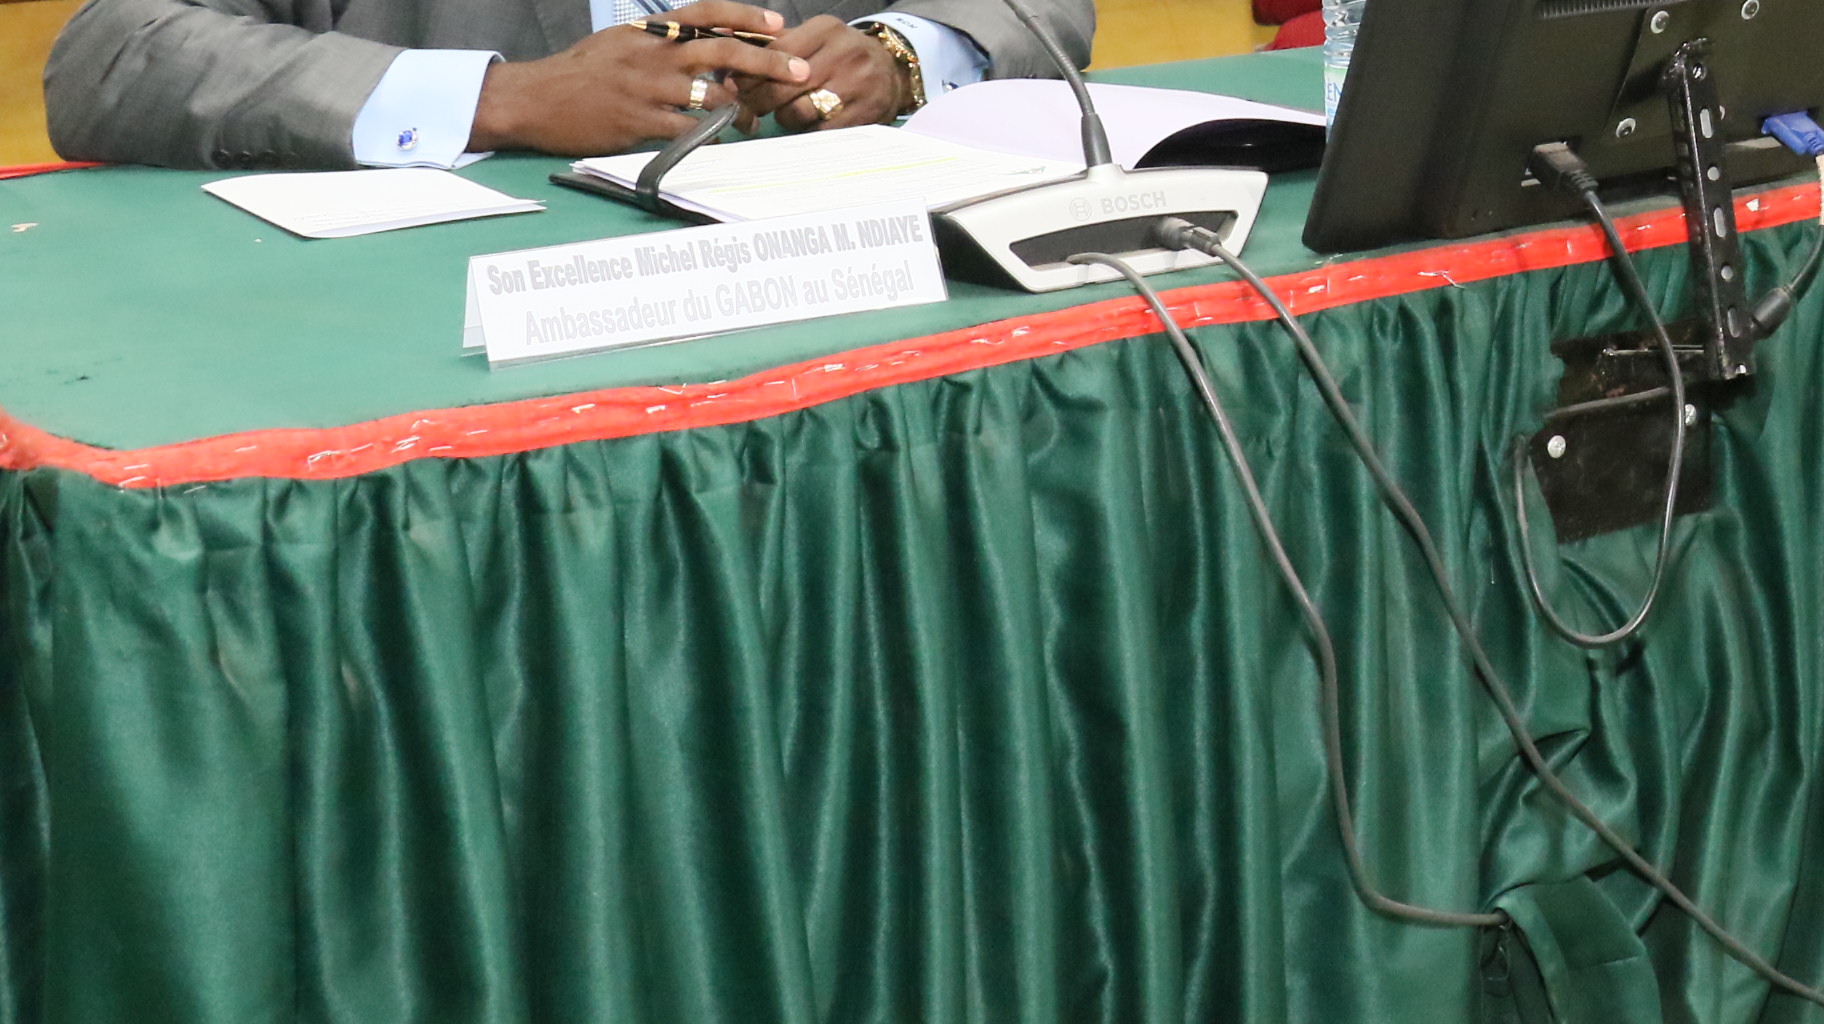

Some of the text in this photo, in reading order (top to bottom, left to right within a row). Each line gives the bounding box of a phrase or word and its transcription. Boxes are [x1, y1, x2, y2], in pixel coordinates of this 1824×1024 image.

[1101, 190, 1167, 214] BOSCH
[486, 214, 924, 295] Son Excellence Michel Régis ONANGA M. NDIAYE
[526, 260, 915, 346] Ambassadeur du GABON au Sénégal
